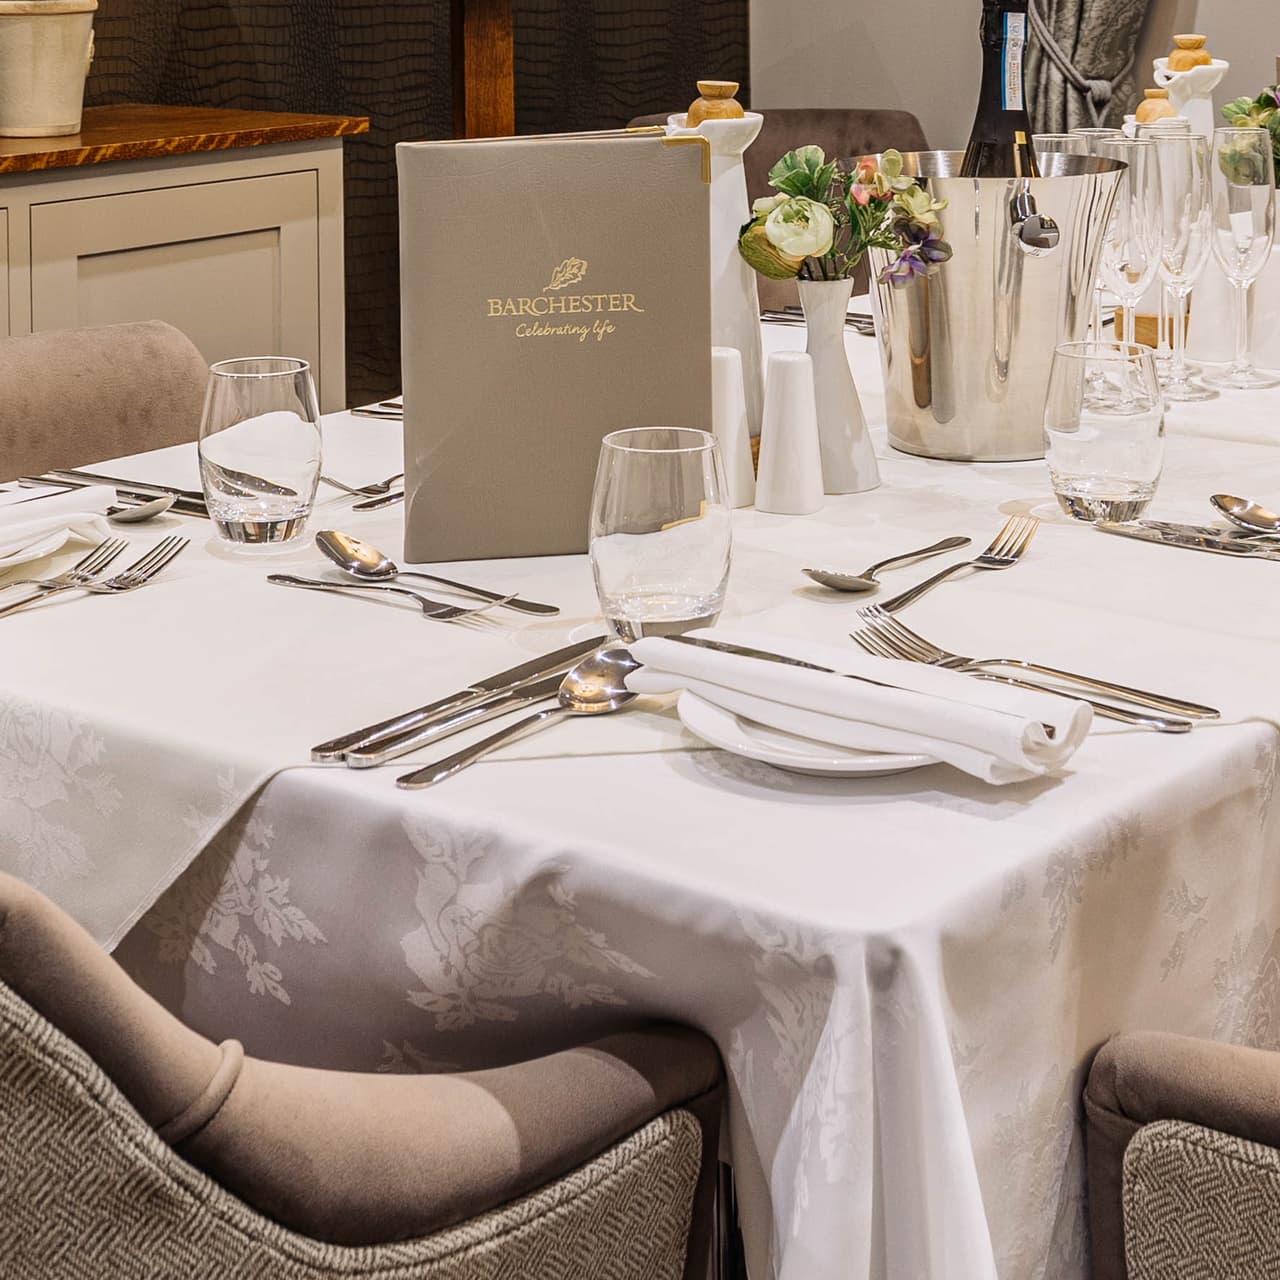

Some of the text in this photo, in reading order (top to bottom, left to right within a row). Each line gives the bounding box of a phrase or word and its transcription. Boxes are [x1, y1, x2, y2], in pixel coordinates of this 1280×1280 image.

[487, 293, 645, 317] BARCHESTER
[515, 319, 616, 343] Celebrating life
